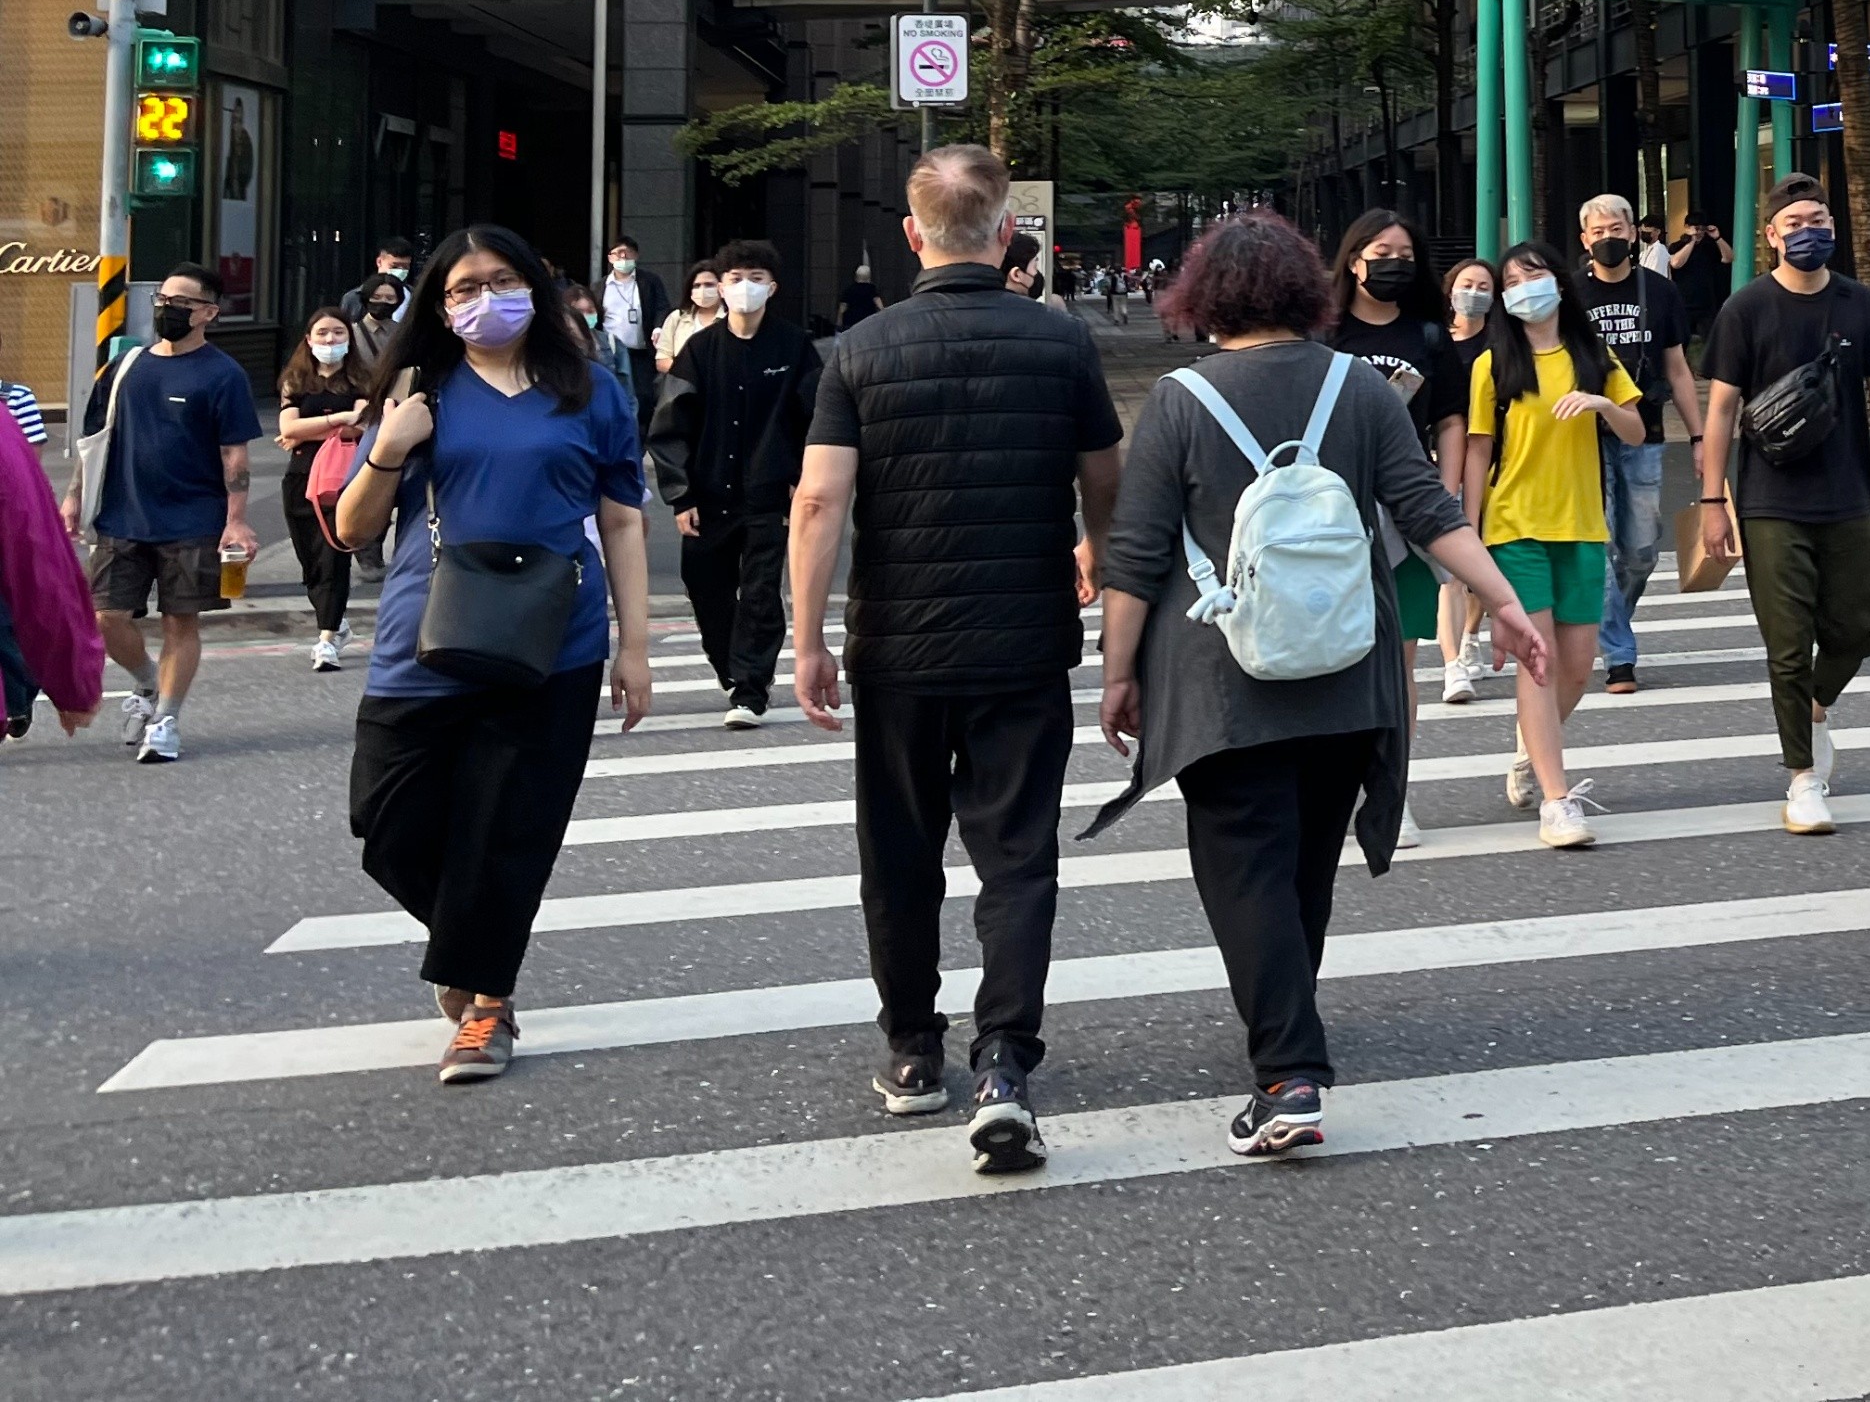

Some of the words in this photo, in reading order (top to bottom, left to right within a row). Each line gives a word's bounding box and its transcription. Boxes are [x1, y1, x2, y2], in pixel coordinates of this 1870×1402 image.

[903, 29, 917, 37] NO
[920, 29, 964, 38] SMOKING
[139, 97, 188, 139] 22
[1599, 319, 1613, 331] TO
[1614, 318, 1636, 331] THE
[1606, 333, 1618, 345] OF
